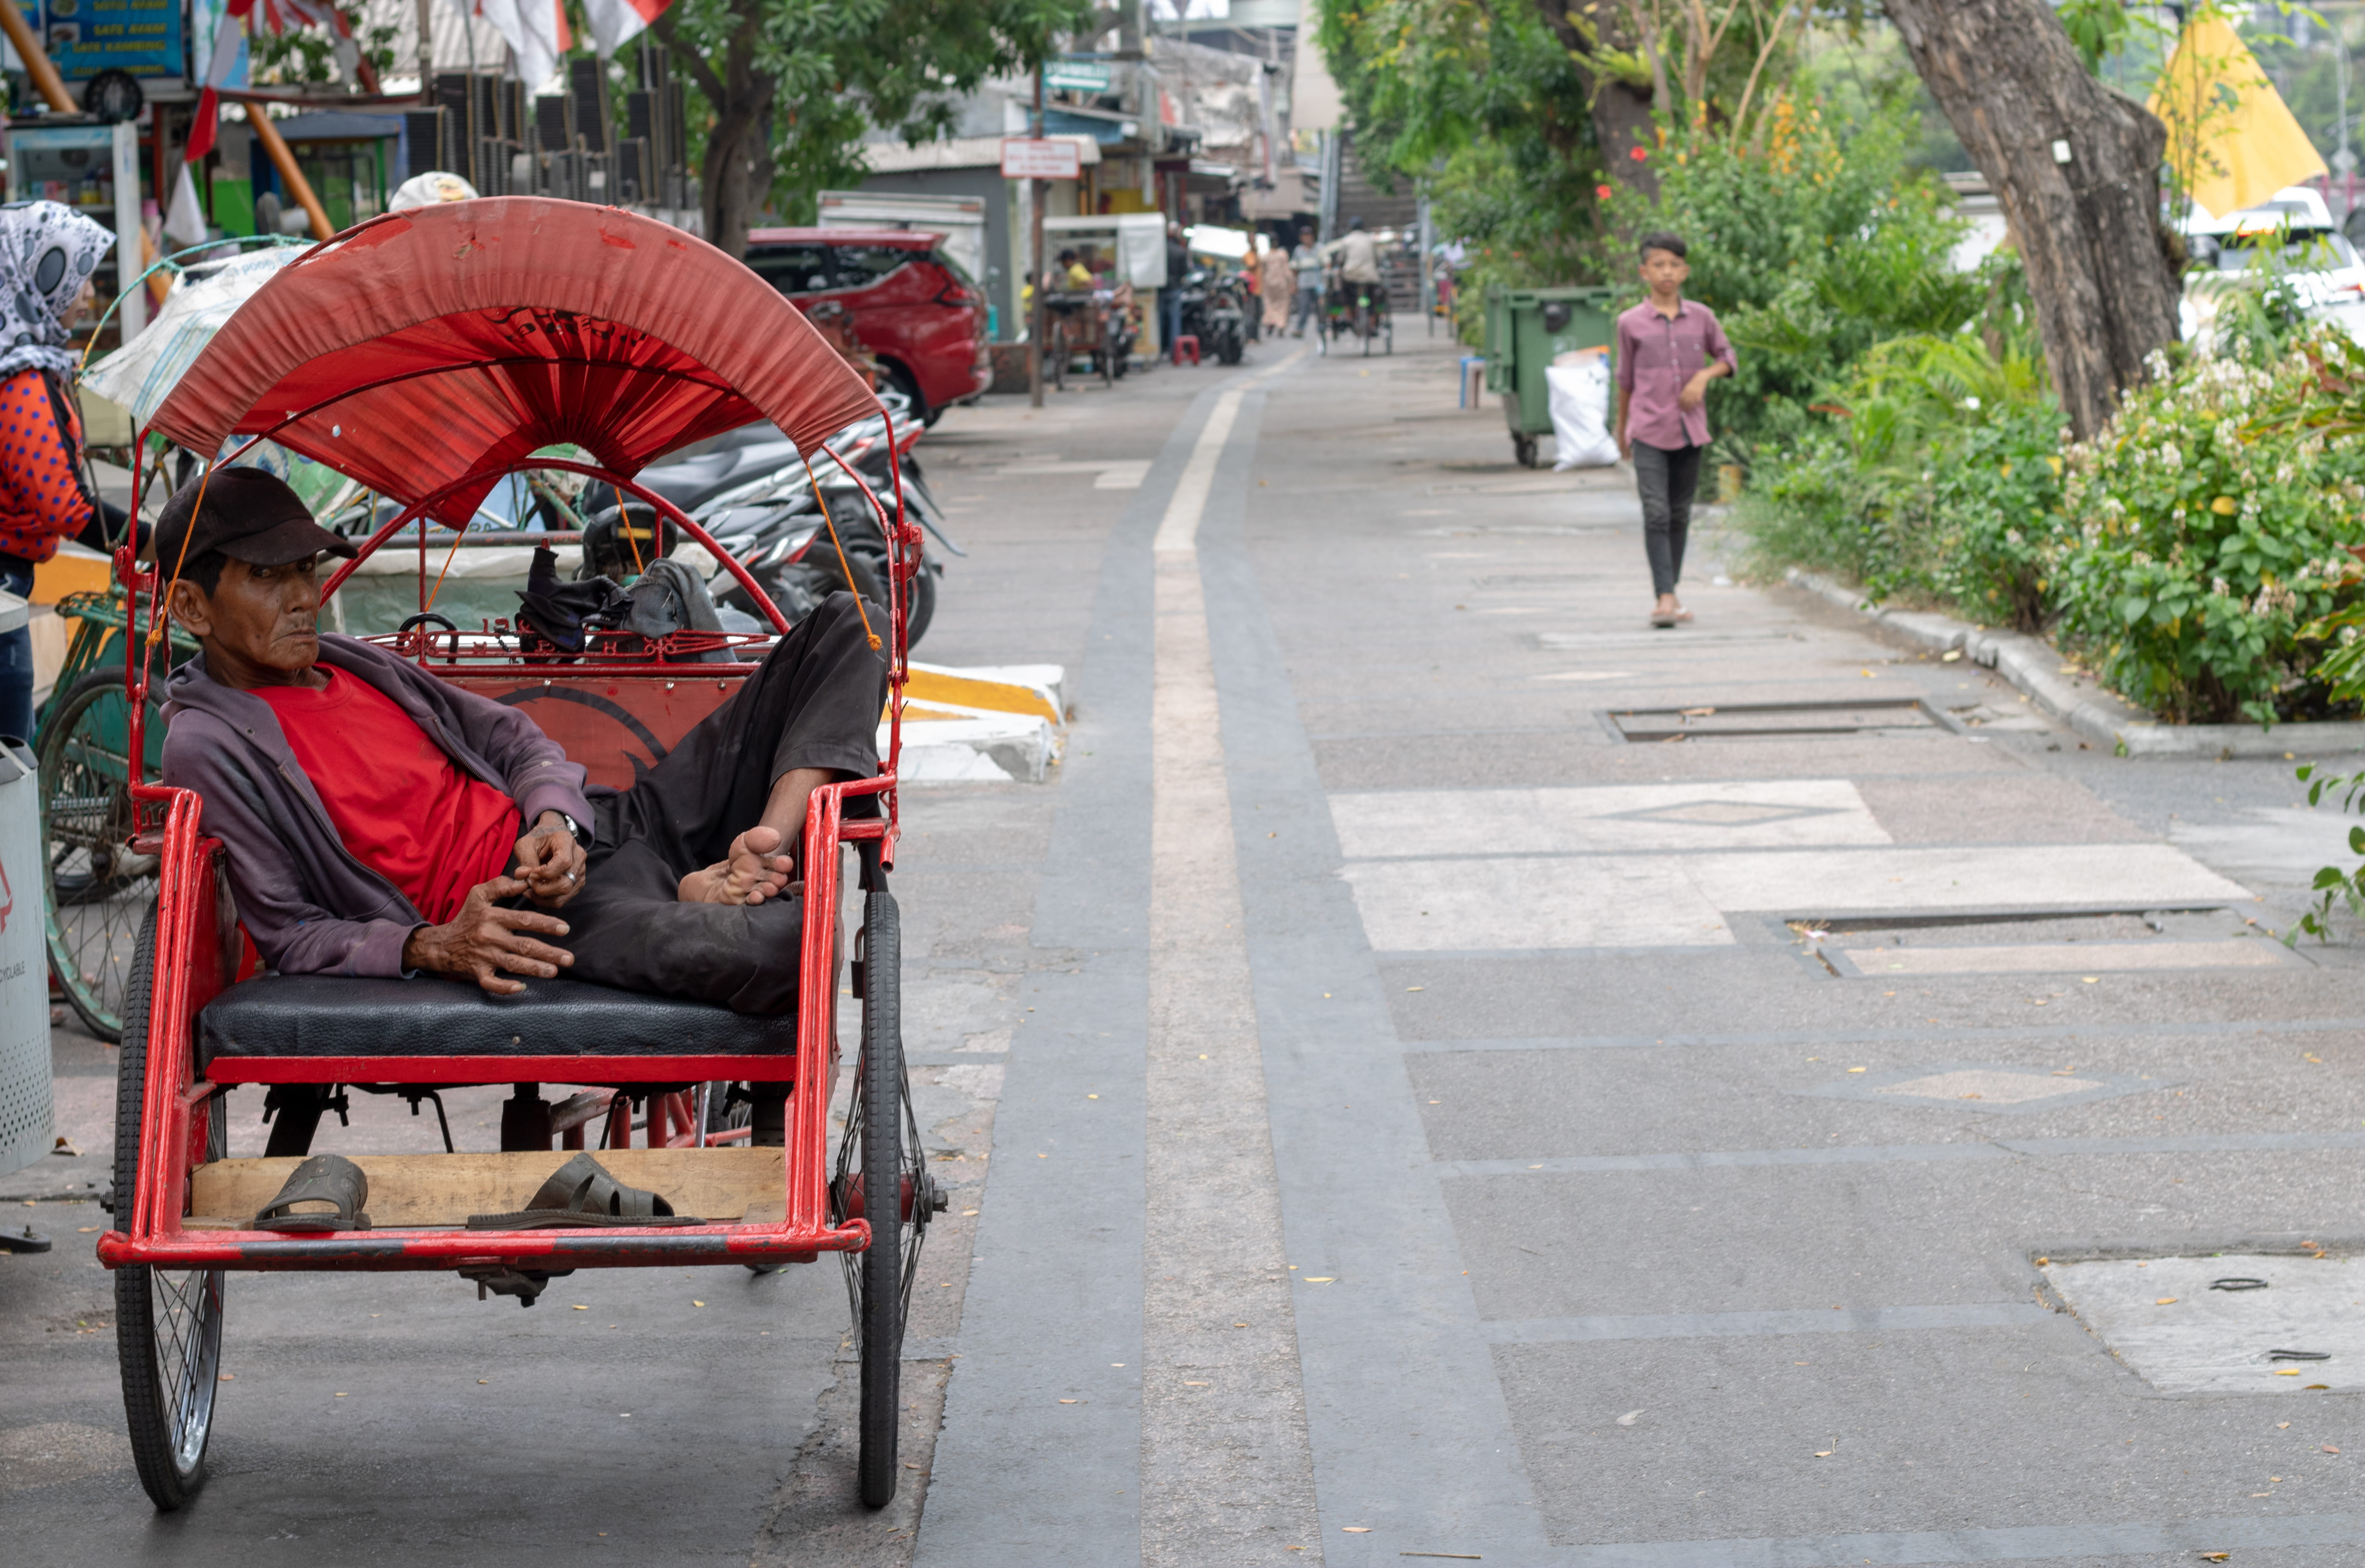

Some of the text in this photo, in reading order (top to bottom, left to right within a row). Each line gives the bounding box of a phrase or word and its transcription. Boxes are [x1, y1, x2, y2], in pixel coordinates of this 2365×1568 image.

[93, 23, 166, 36] SATE AYAM
[72, 40, 166, 53] SATE KAMBING
